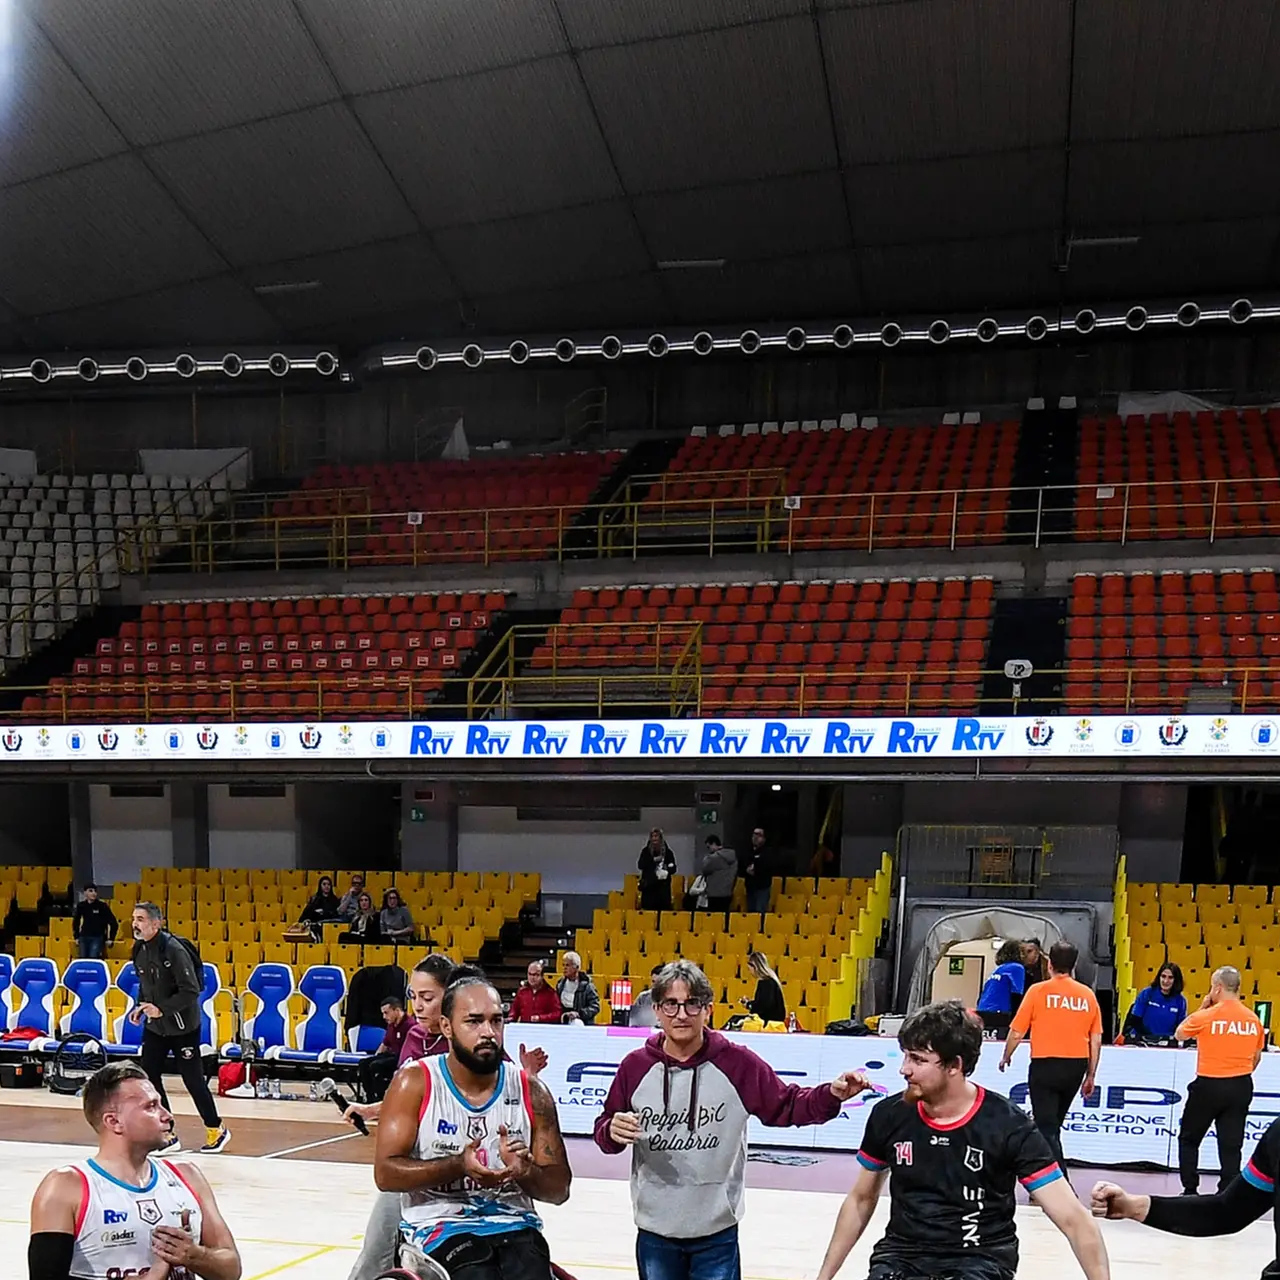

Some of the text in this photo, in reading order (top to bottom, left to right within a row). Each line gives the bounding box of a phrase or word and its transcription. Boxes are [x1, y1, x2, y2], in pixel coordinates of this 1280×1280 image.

[1046, 994, 1089, 1012] ITALIA
[1211, 1020, 1257, 1036] ITALIA
[649, 1132, 720, 1152] Calabria
[893, 1141, 913, 1166] 14
[103, 1209, 128, 1225] RTV
